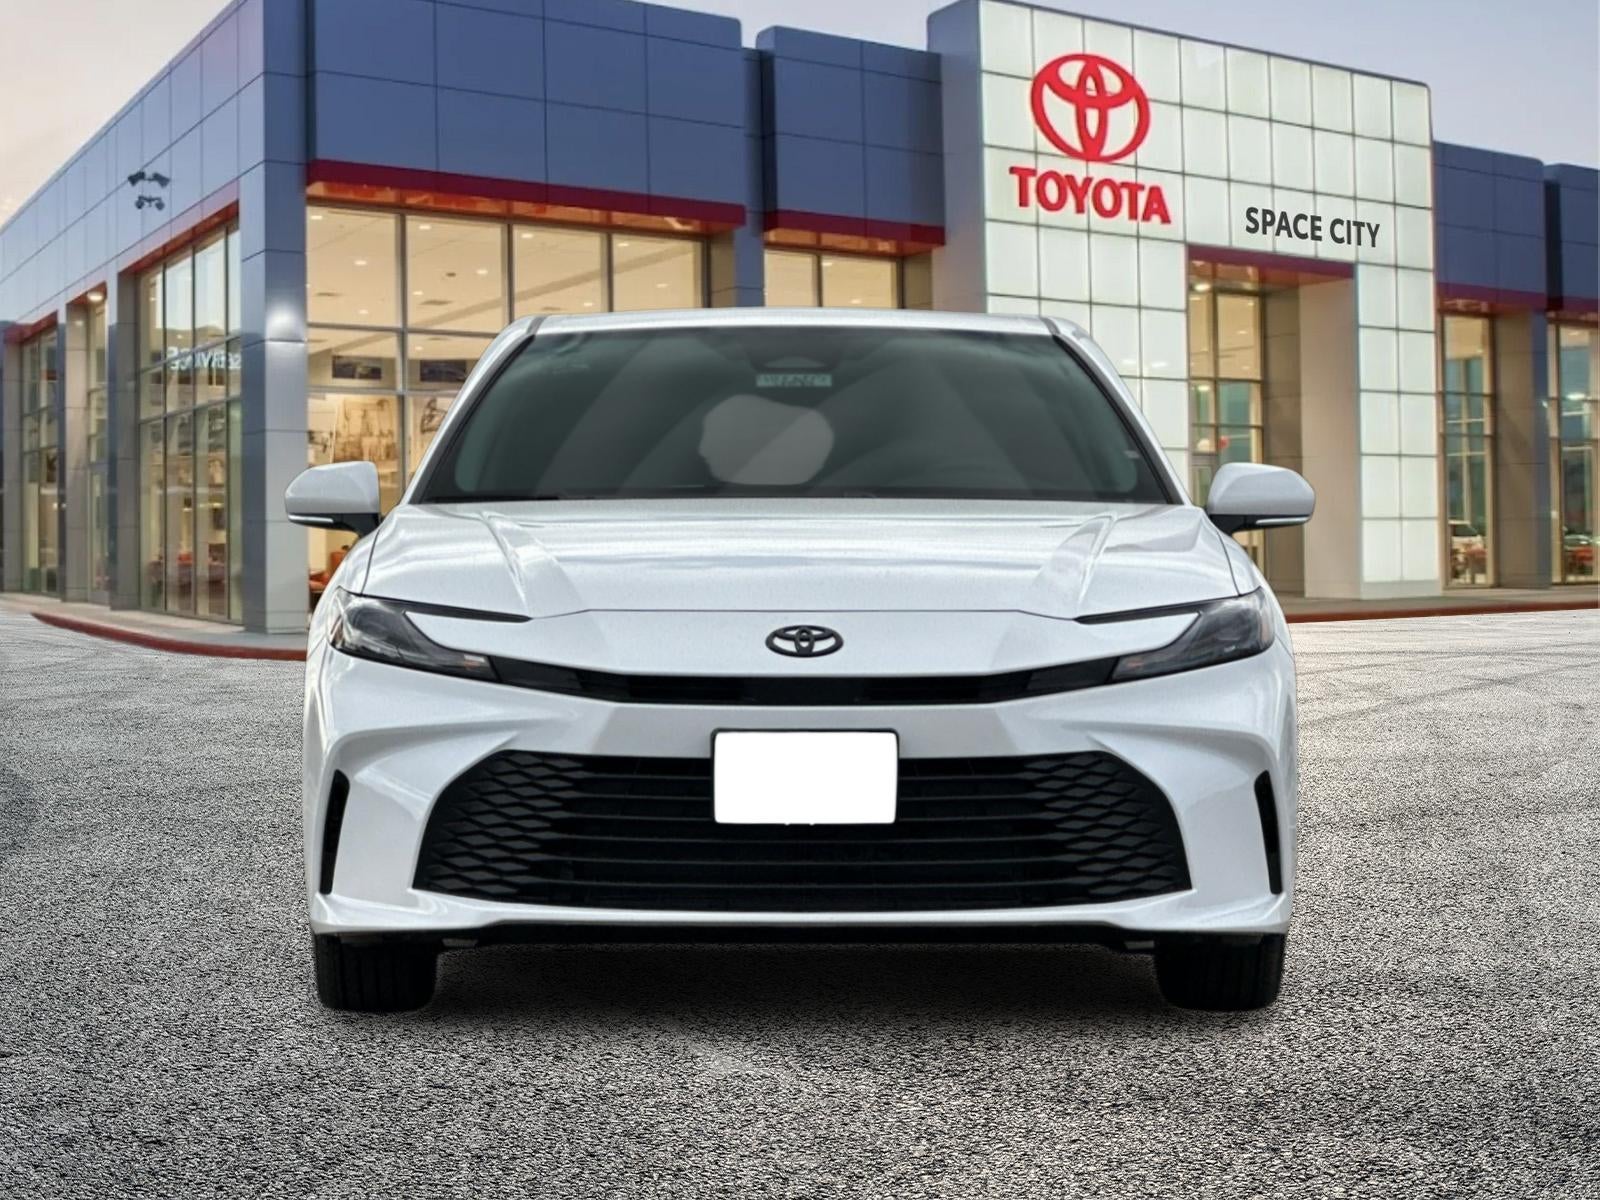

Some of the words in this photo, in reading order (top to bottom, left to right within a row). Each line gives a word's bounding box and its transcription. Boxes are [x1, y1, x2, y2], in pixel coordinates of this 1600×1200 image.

[1009, 166, 1171, 225] TOYOTA
[1245, 206, 1323, 242] SPACE
[1329, 217, 1381, 248] CITY
